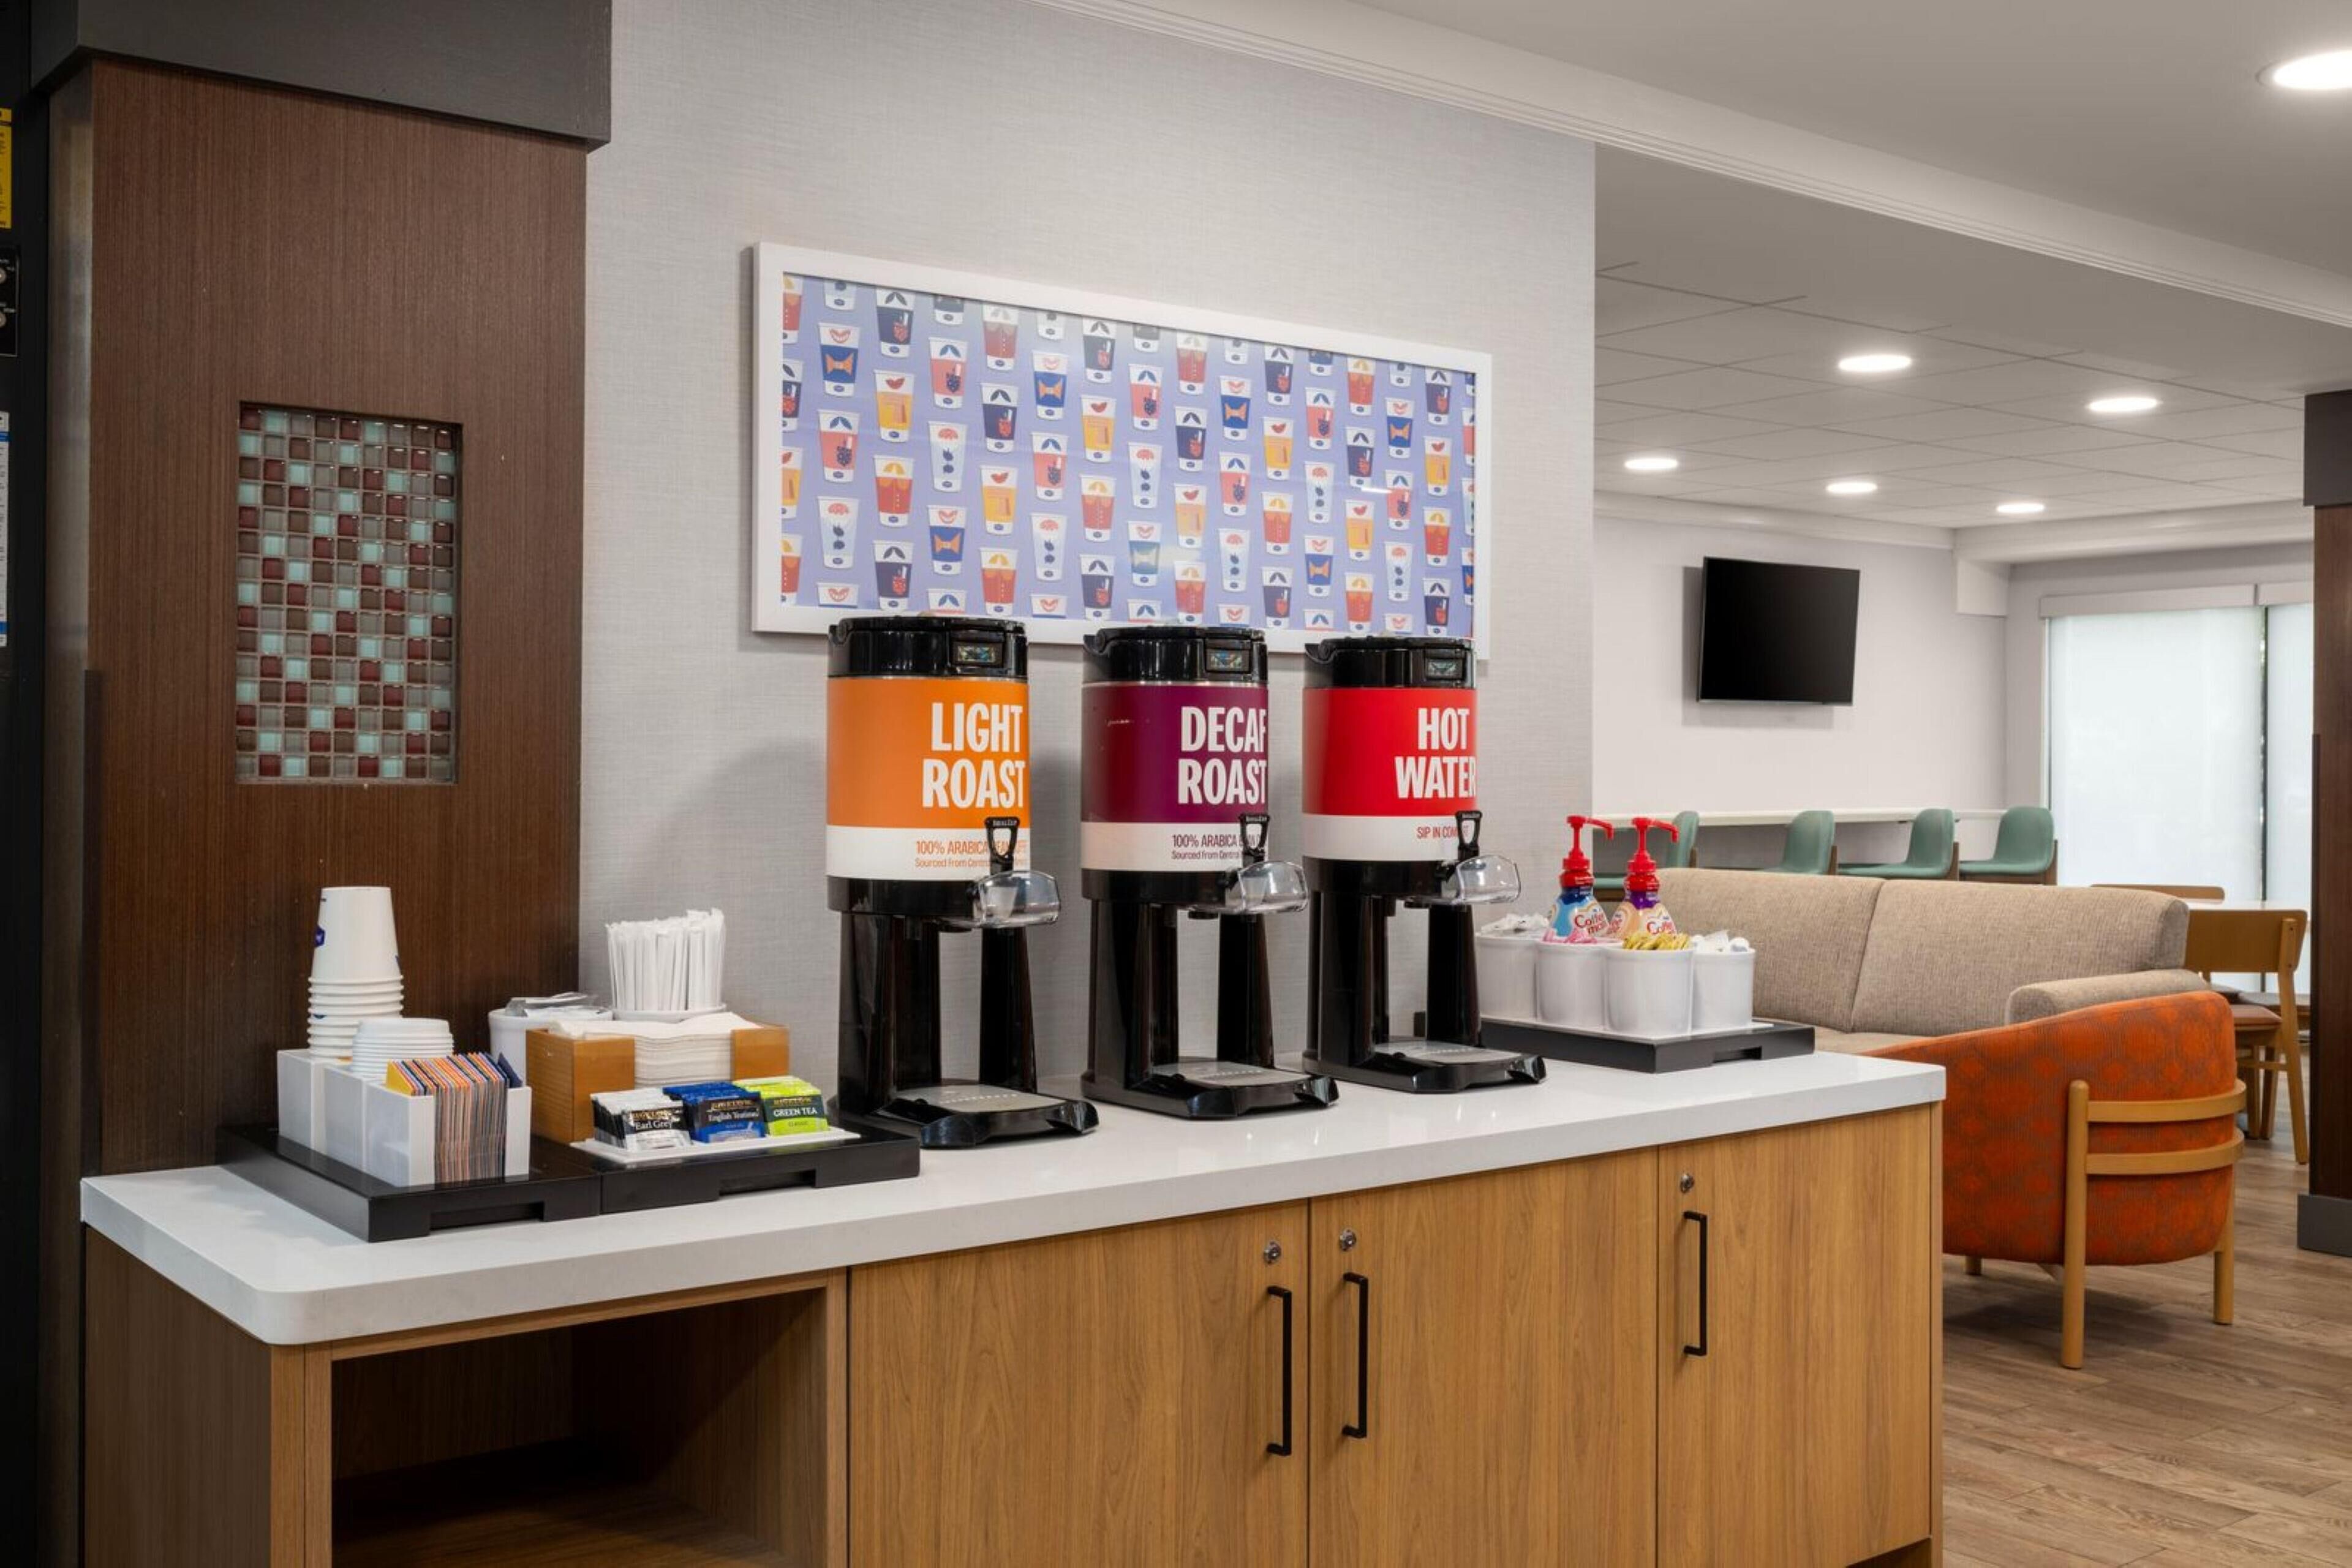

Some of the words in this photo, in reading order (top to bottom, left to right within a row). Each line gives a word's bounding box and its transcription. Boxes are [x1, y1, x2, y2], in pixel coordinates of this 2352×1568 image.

[931, 703, 1023, 753] LIGHT
[1181, 706, 1266, 753] DECAF
[1418, 708, 1469, 750] HOT
[922, 758, 1026, 809] ROAST
[1178, 758, 1267, 805] ROAST
[1417, 826, 1430, 839] SIP
[1433, 826, 1440, 838] IN
[916, 840, 944, 854] 100%
[948, 840, 988, 854] ARABICA
[1172, 834, 1199, 848] 100%
[1200, 834, 1237, 847] ARABICA
[1172, 850, 1200, 859] Sourced
[916, 858, 946, 867] Sourced
[709, 1112, 732, 1122] English
[774, 1107, 801, 1117] GREEN
[801, 1107, 818, 1115] TEA
[635, 1120, 652, 1131] Earl
[653, 1120, 672, 1129] Grey
